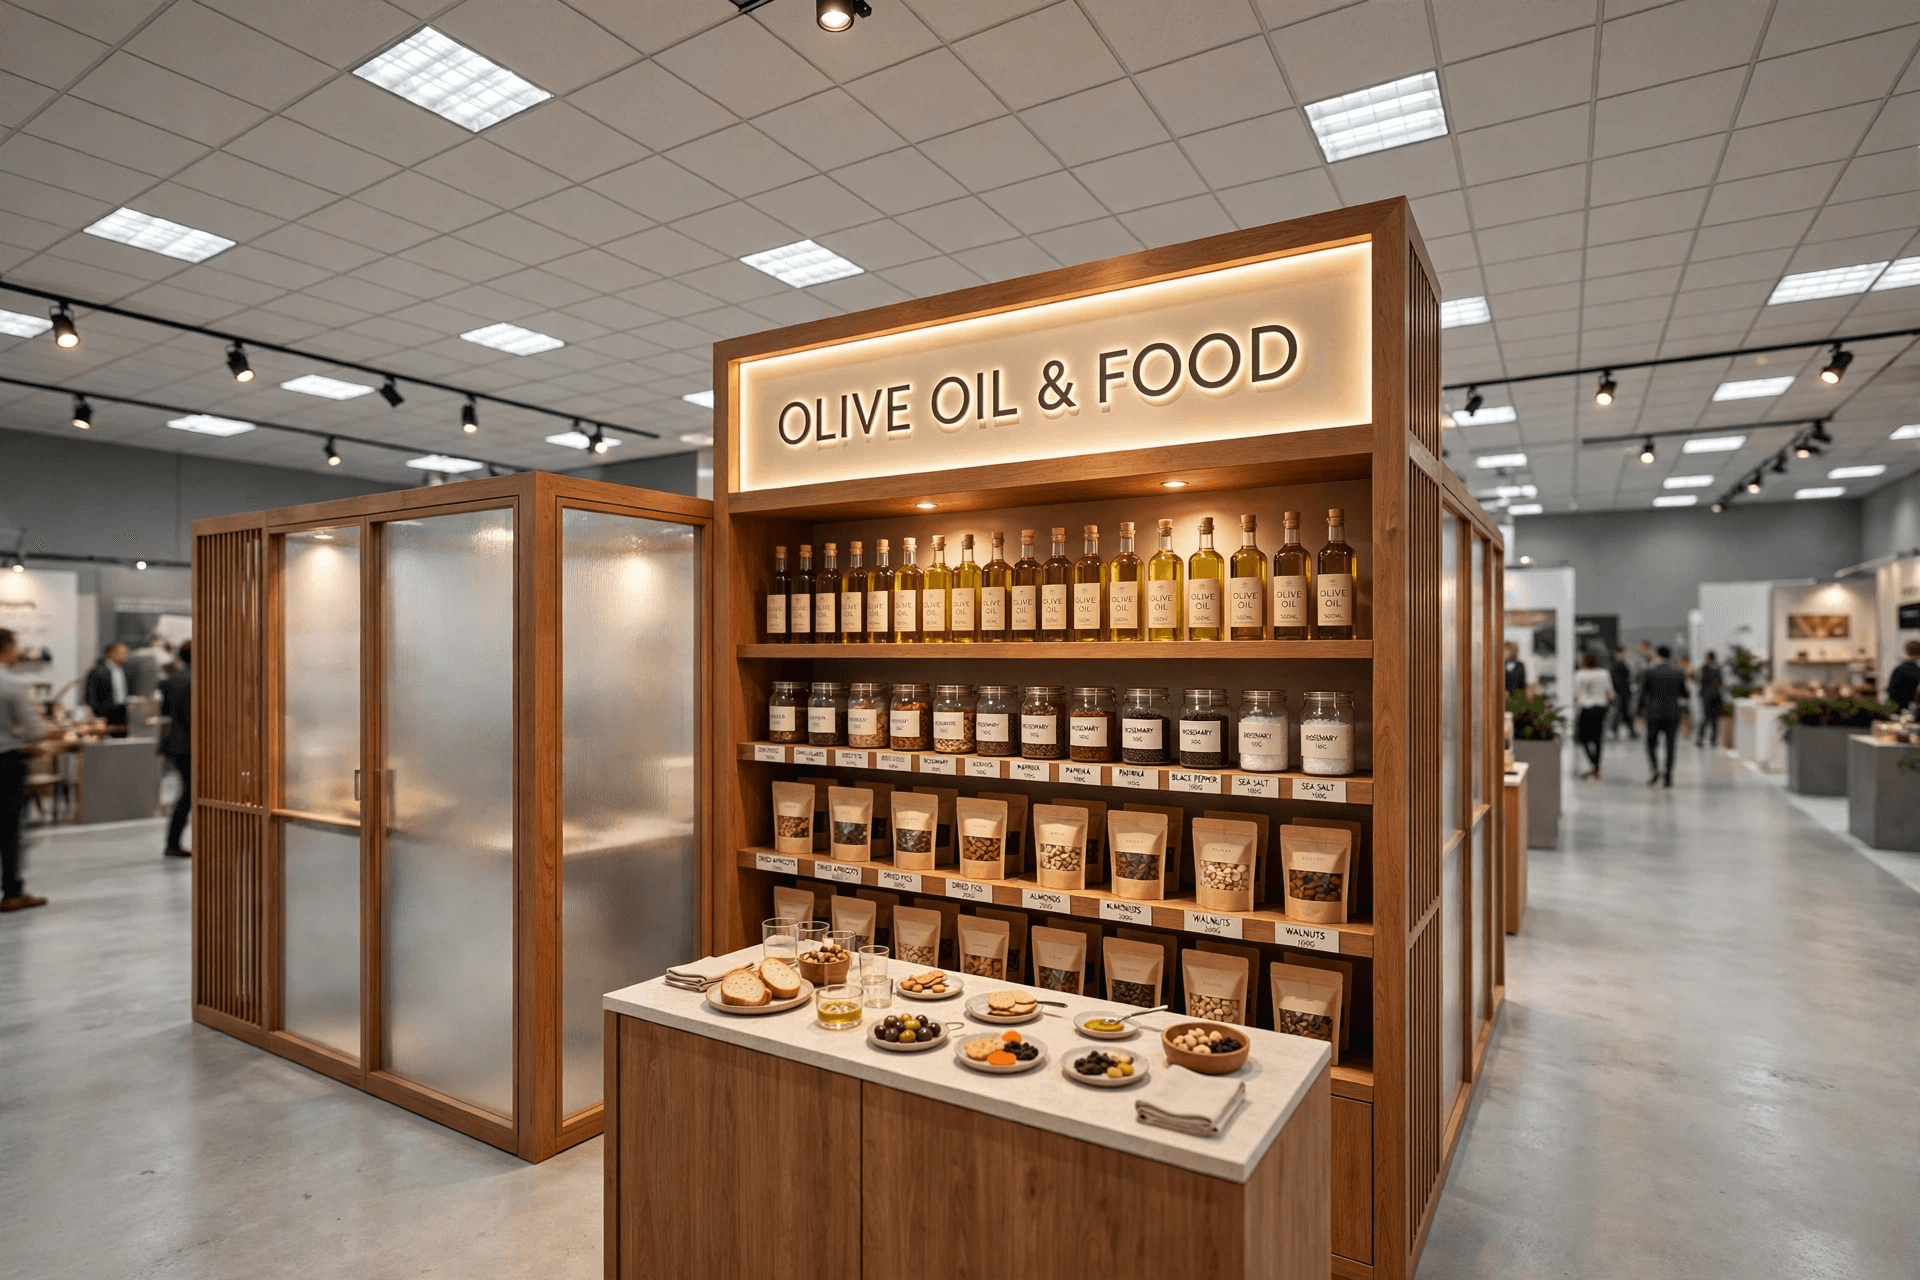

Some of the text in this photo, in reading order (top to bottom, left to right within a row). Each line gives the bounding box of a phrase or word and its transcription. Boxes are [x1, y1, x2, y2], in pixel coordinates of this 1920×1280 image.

[778, 324, 1299, 446] OLIVE OIL & FOOD
[1191, 593, 1215, 601] OLIVE
[1277, 591, 1302, 599] OLIVE
[1320, 589, 1347, 597] OLIVE
[1043, 597, 1063, 605] OLIVE
[1238, 601, 1253, 609] OIL
[1281, 600, 1297, 608] OIL
[1325, 599, 1342, 607] OIL
[1154, 603, 1168, 611] OIL
[1195, 602, 1210, 610] OIL
[1238, 778, 1270, 787] SEA SALT
[1301, 782, 1335, 792] SEA SALT
[1030, 892, 1061, 903] ALMONDS
[1193, 914, 1231, 927] WALNUTS
[1285, 927, 1326, 940] WALNUTS
